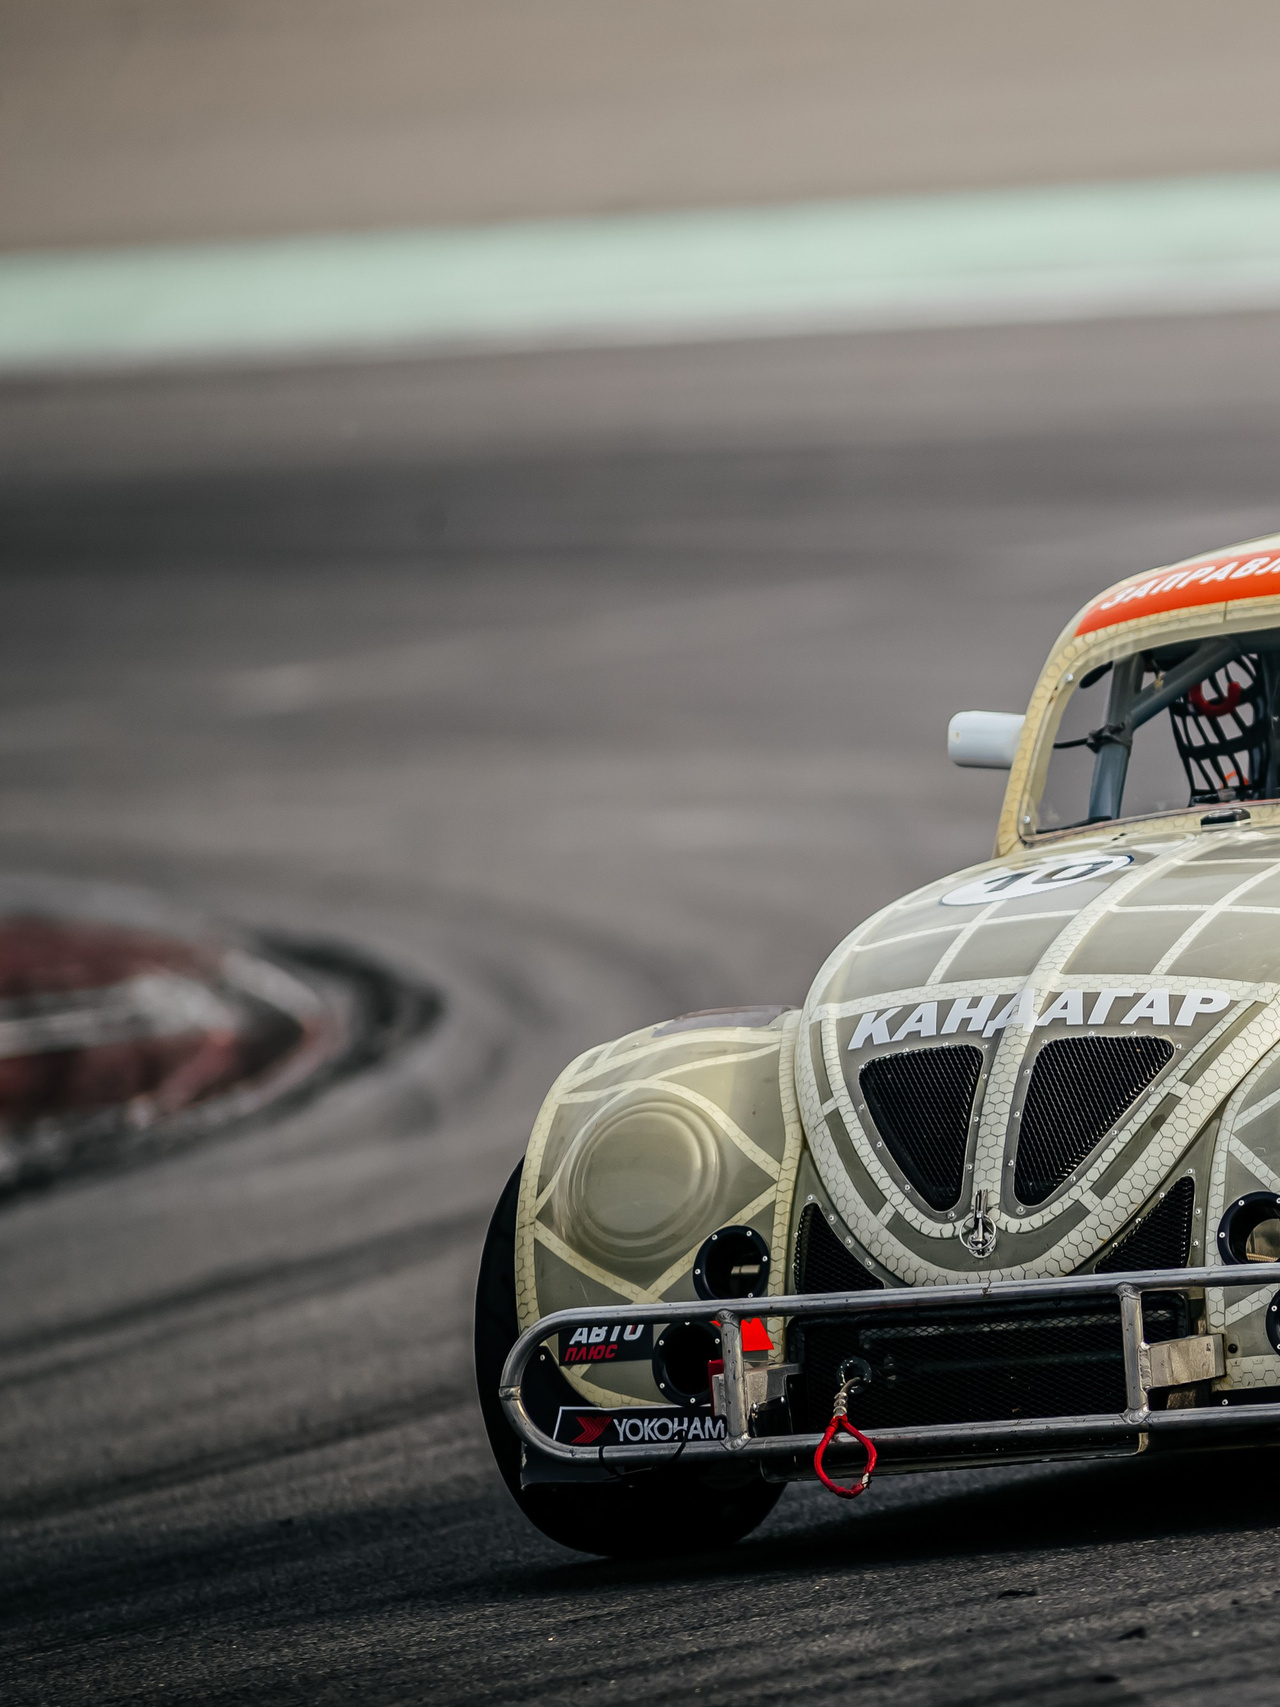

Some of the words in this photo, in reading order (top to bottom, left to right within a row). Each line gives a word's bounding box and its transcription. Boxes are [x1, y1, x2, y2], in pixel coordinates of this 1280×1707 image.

[983, 860, 1113, 894] 10
[847, 989, 1231, 1050] КАНДАГАР
[564, 1343, 618, 1362] ПЛЮС
[612, 1416, 726, 1442] YOKOHAM
